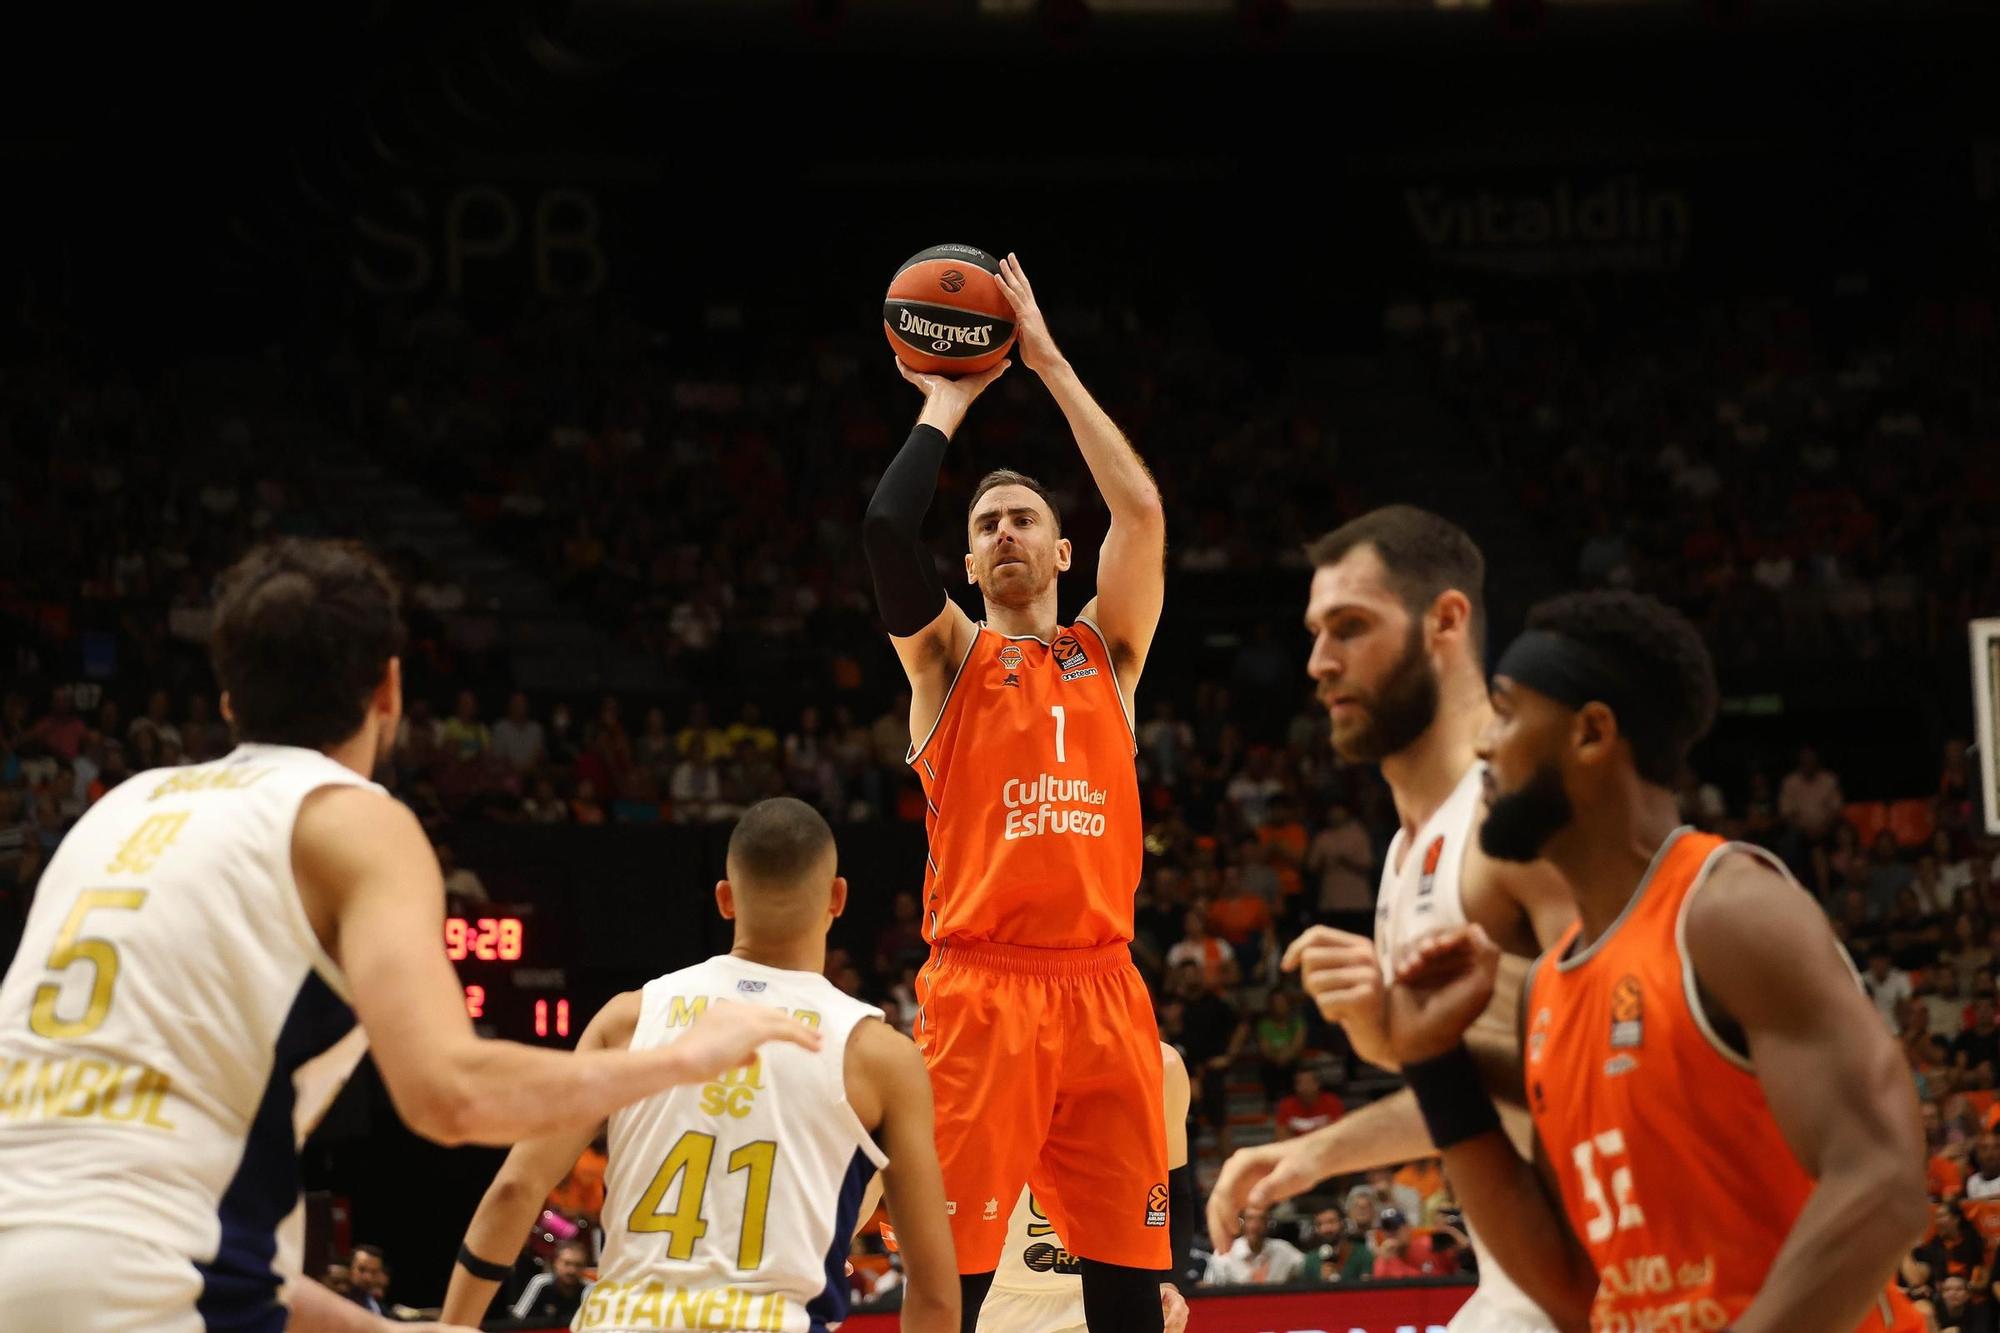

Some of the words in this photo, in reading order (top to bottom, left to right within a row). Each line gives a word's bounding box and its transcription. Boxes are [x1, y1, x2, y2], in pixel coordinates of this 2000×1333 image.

[899, 307, 993, 347] SPALDING
[1051, 705, 1066, 762] 1
[1003, 773, 1089, 808] Cultura
[1088, 789, 1107, 805] del
[28, 889, 149, 1039] 5
[535, 1000, 569, 1037] 11
[700, 1083, 754, 1118] SC
[628, 1130, 777, 1270] 41
